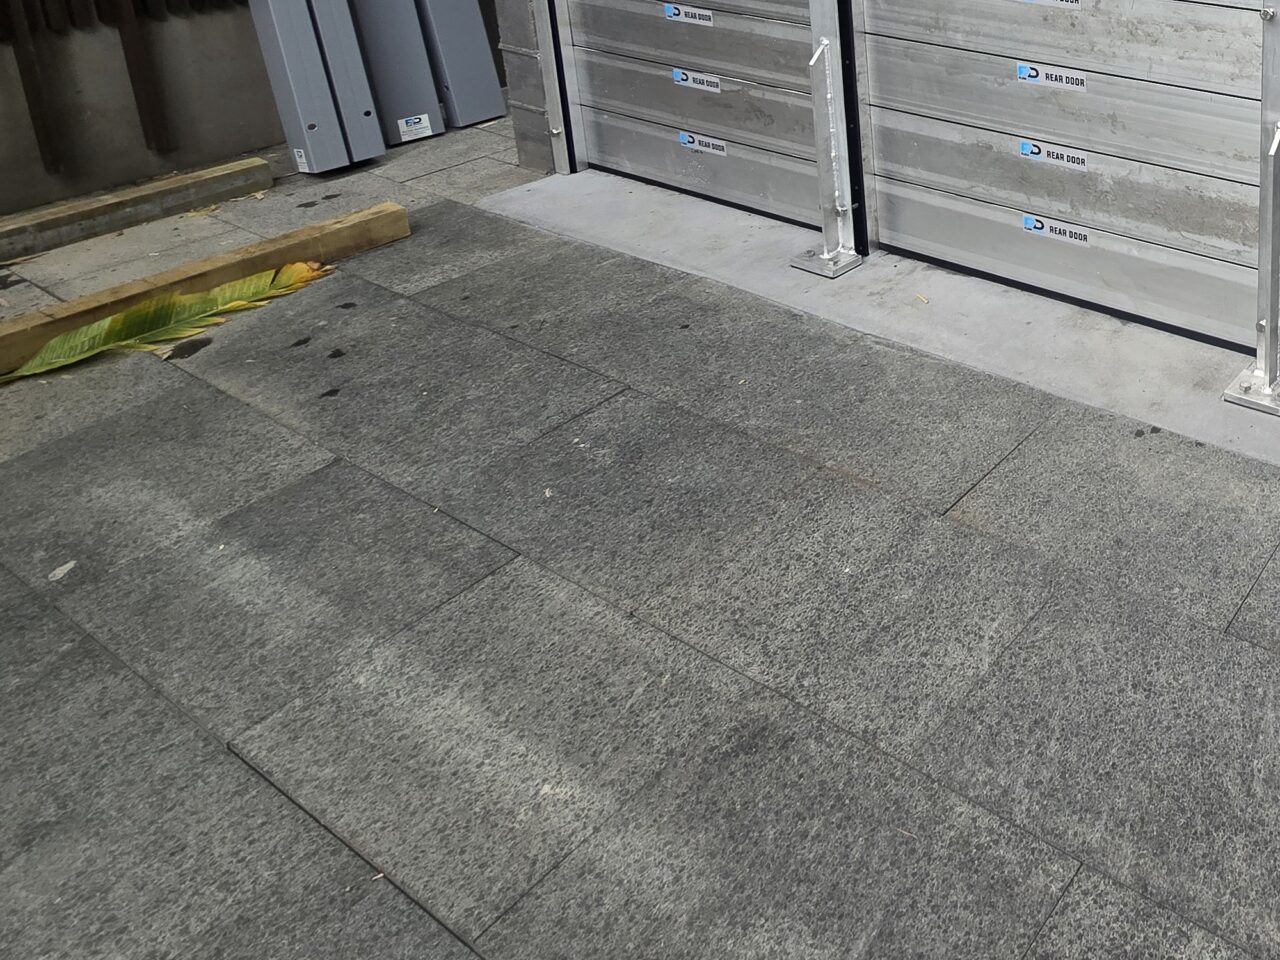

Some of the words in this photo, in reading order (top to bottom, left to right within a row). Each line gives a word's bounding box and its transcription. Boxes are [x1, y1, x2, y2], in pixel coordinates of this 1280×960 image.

[1045, 73, 1063, 84] REAR
[1066, 76, 1084, 87] DOOR
[1047, 150, 1064, 161] REAR
[1067, 154, 1086, 166] DOOR
[1050, 225, 1067, 237] REAR
[1069, 230, 1088, 242] DOOR
